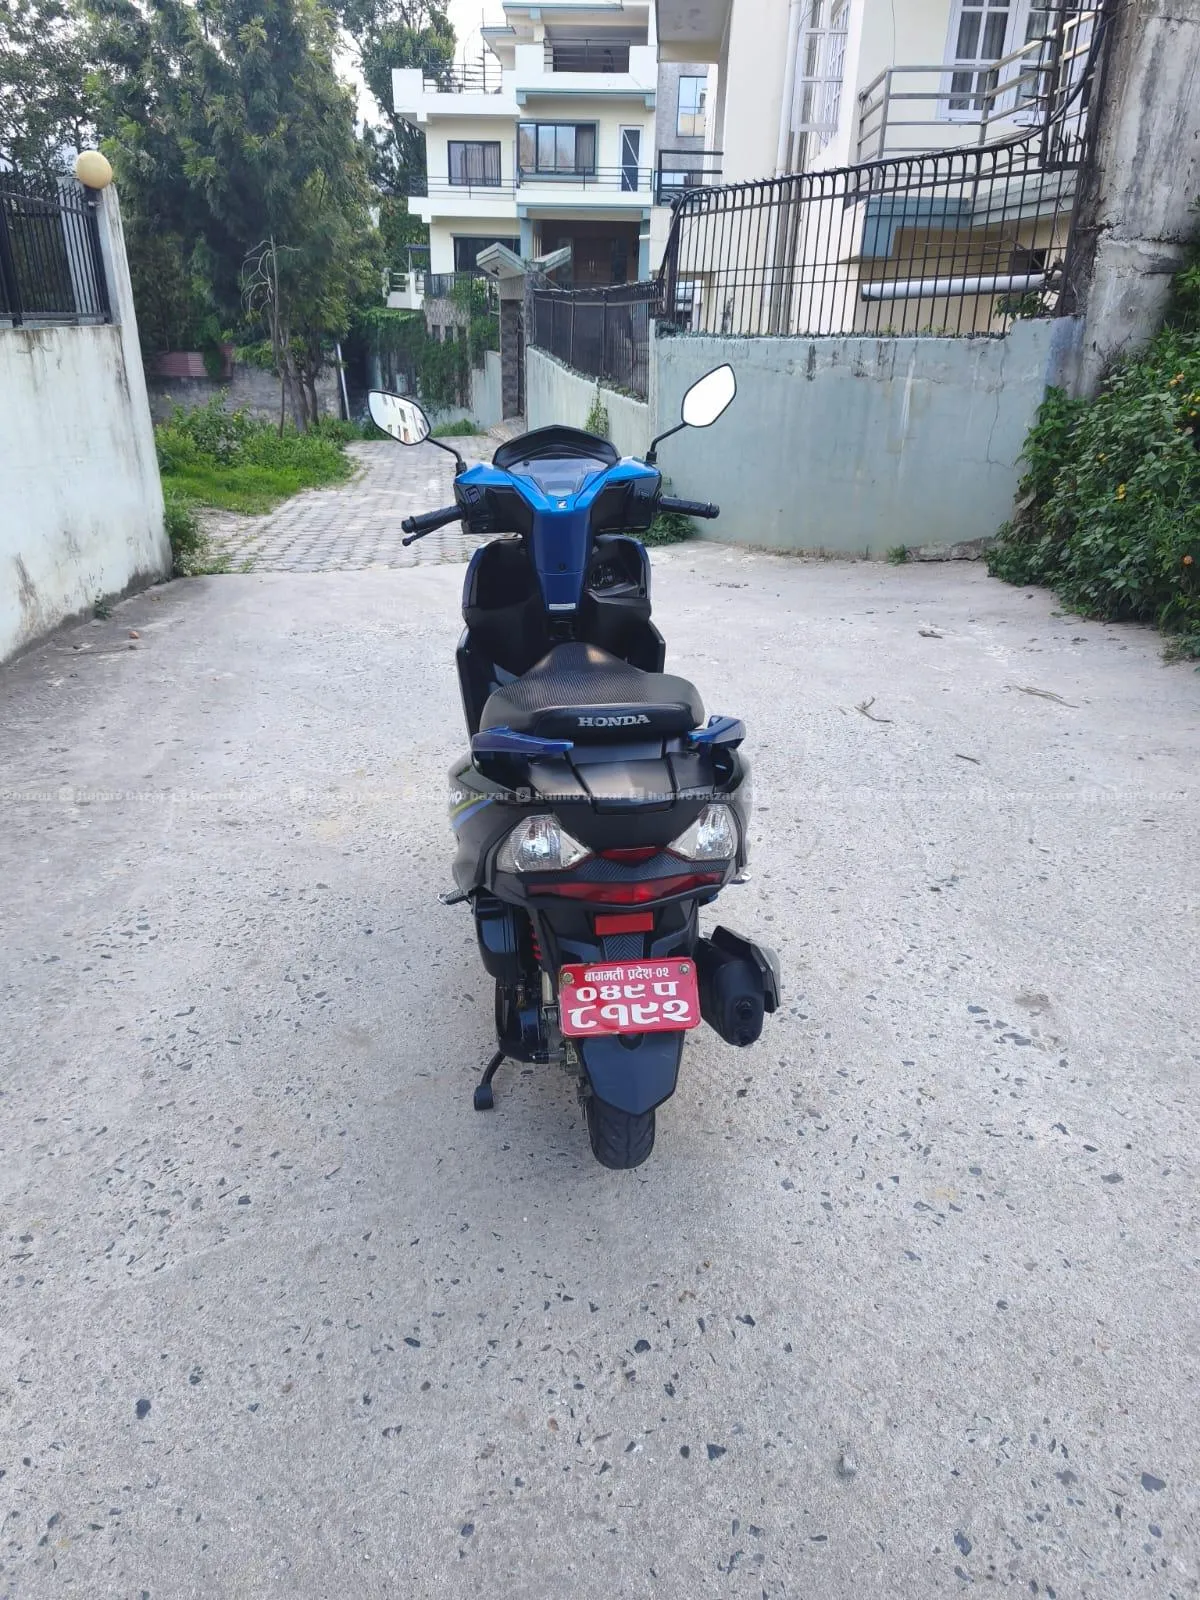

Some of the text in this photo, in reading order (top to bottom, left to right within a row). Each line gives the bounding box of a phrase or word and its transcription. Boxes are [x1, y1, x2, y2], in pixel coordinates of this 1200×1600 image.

[577, 714, 652, 727] HONDA
[584, 966, 624, 982] बागमती
[652, 980, 680, 996] प
